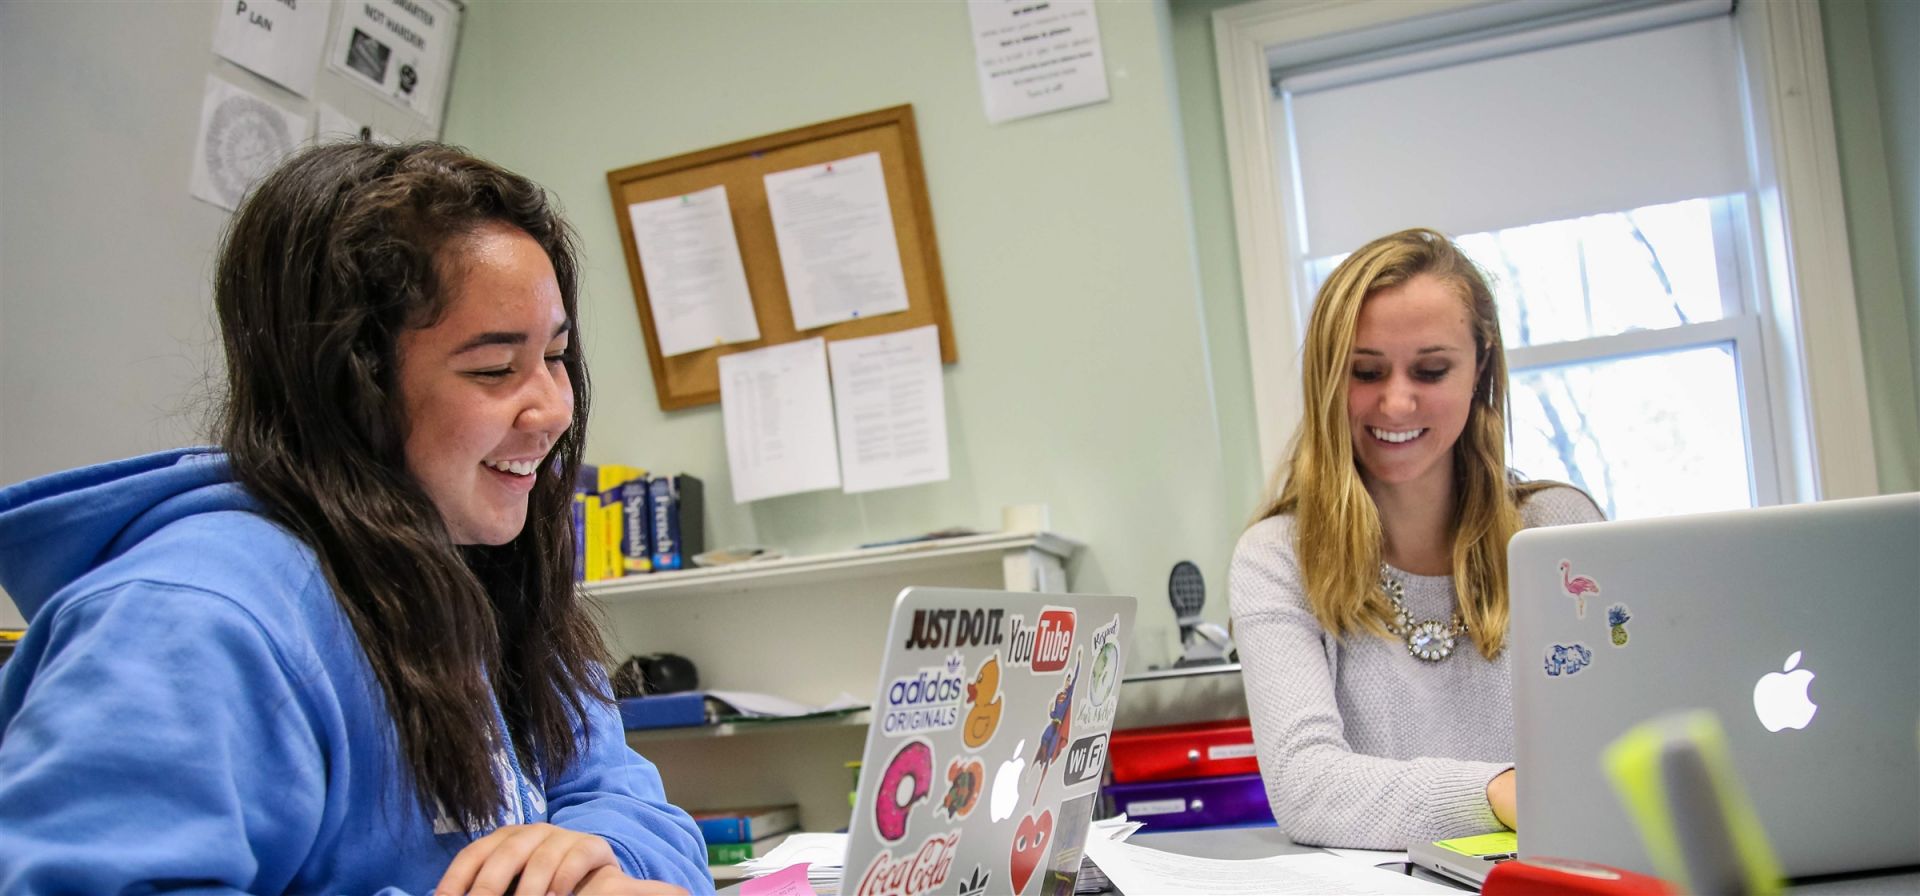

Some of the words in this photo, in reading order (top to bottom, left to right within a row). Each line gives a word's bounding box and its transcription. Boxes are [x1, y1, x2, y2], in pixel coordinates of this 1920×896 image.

[364, 3, 385, 25] NOT
[386, 17, 426, 49] HARDER
[624, 496, 647, 557] Spanish
[655, 495, 673, 552] French
[905, 609, 957, 650] JUST
[955, 608, 986, 647] DO
[889, 672, 962, 706] adidas
[884, 706, 957, 732] ORIGINALS
